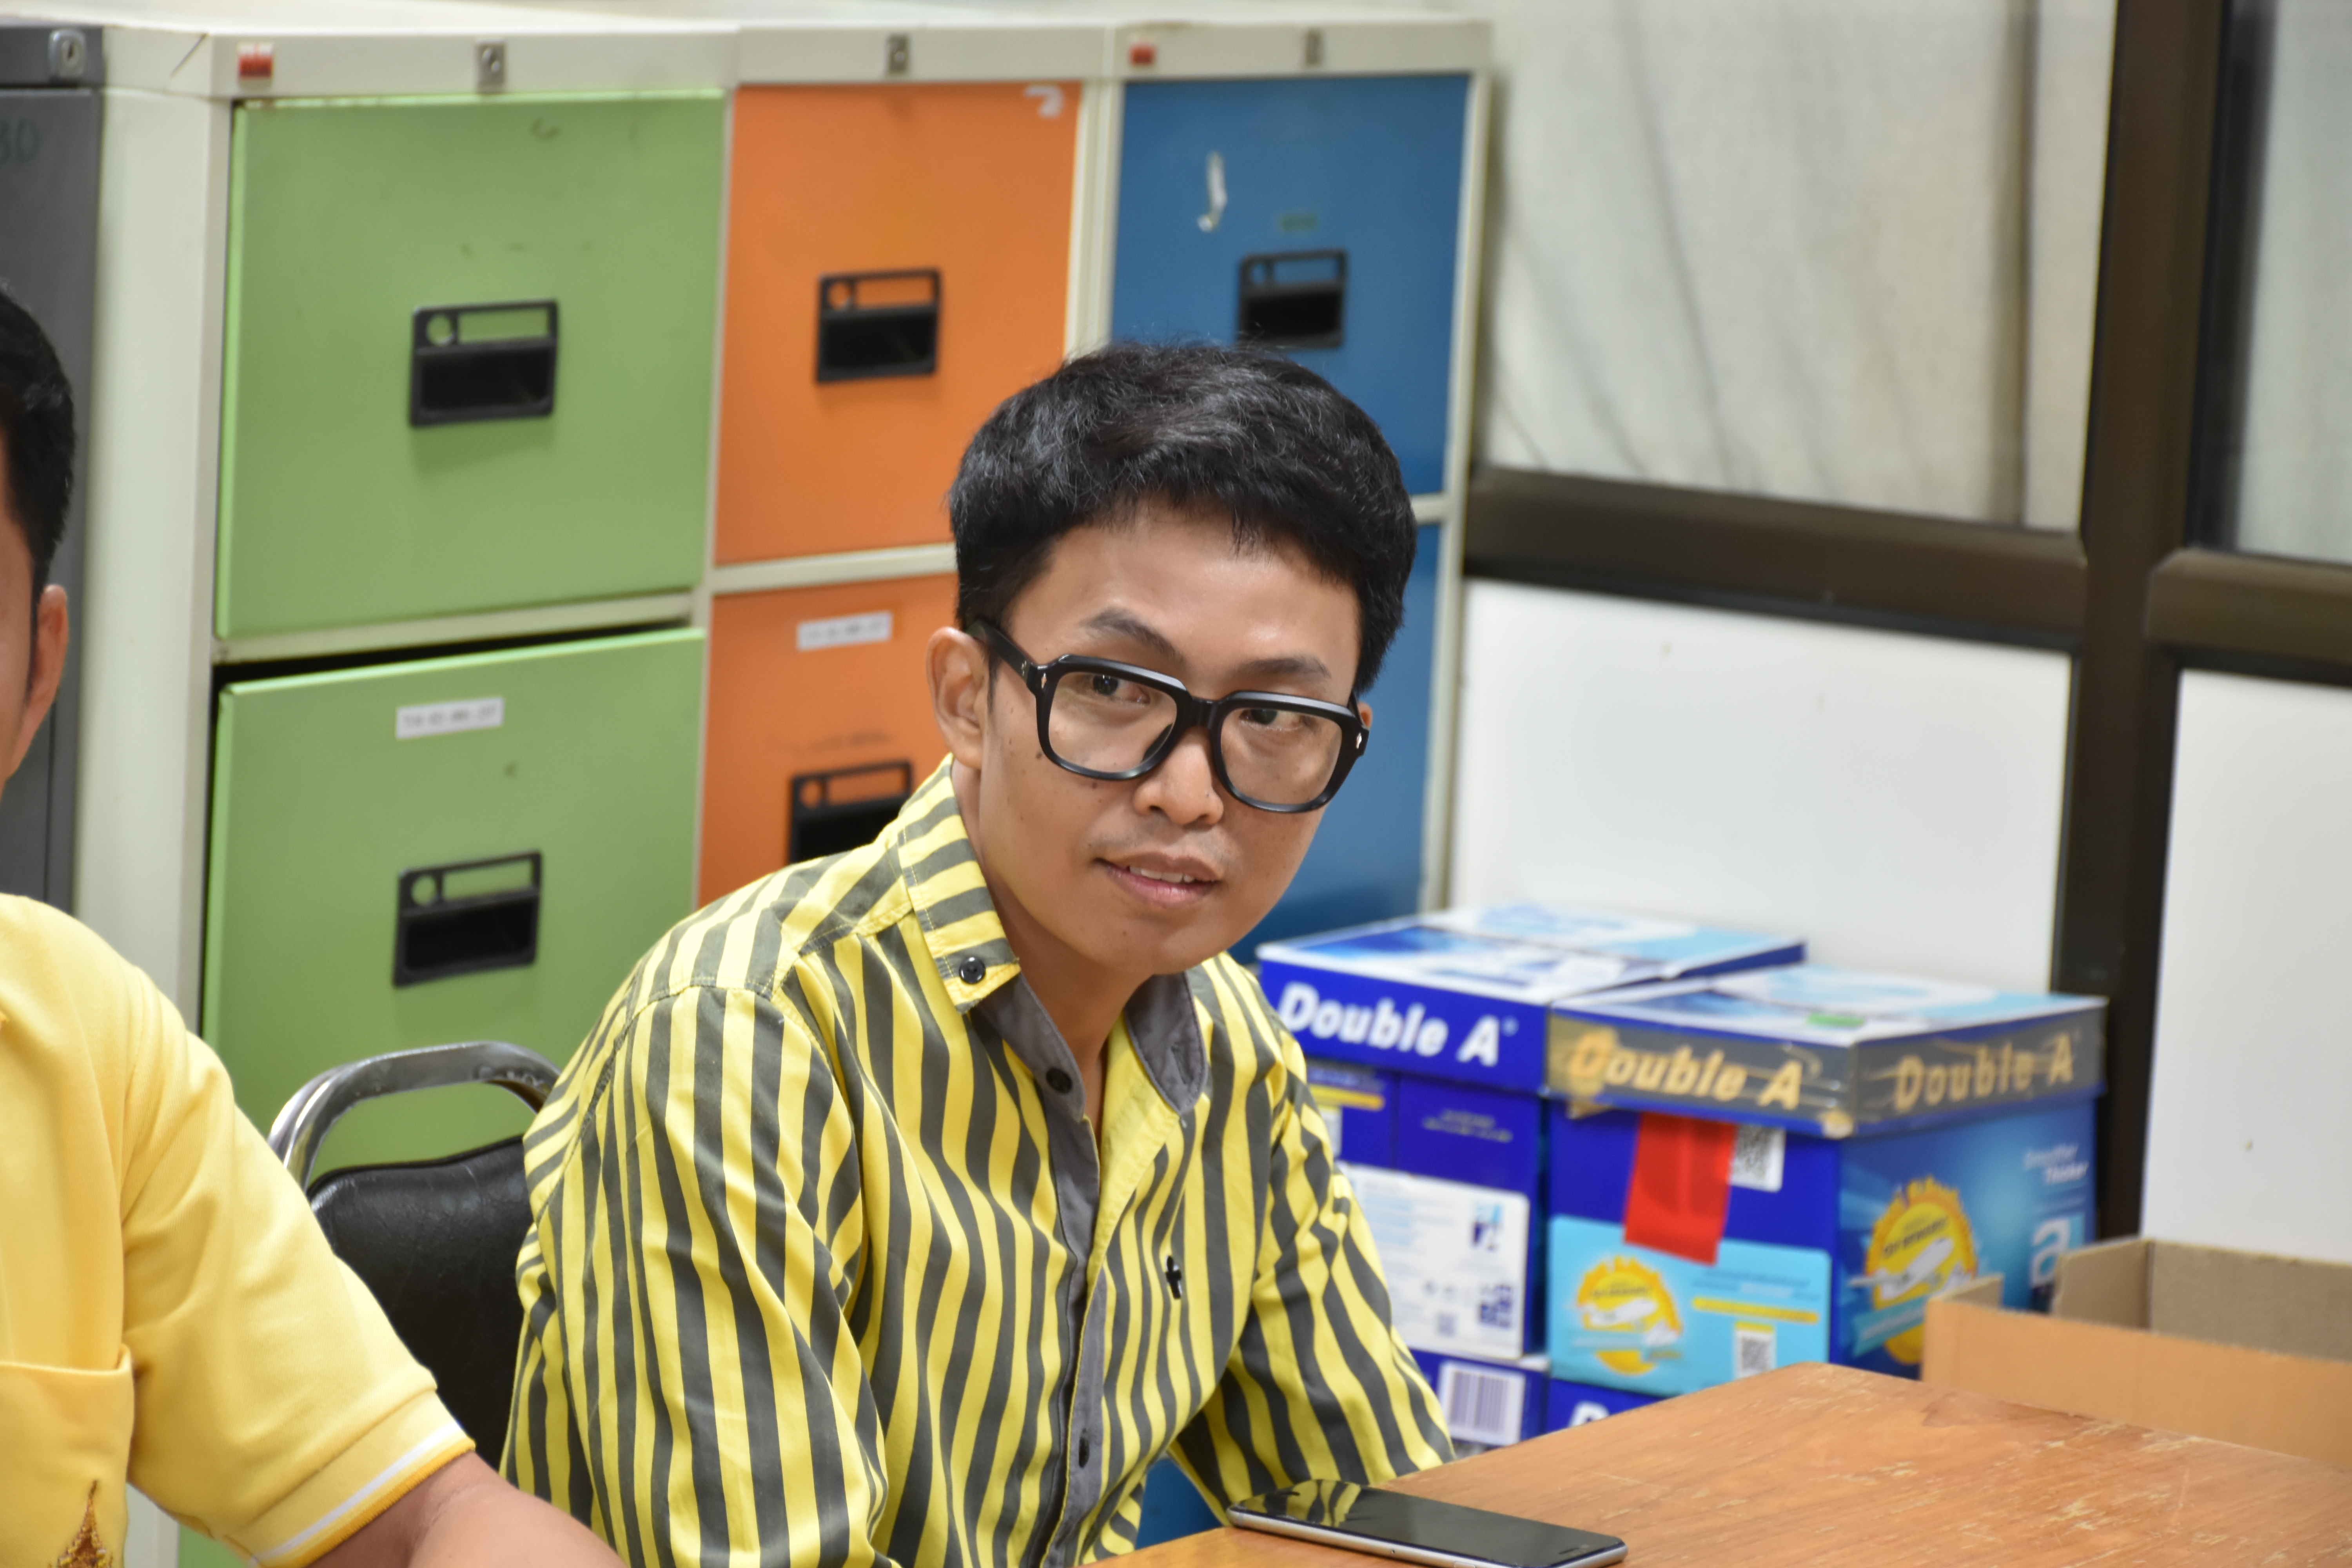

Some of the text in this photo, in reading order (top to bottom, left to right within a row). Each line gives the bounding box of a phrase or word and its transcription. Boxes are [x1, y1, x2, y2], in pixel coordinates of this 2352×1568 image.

[1277, 982, 1500, 1067] Double A
[1570, 1029, 1804, 1109] Double A
[1896, 1034, 2073, 1110] Double A
